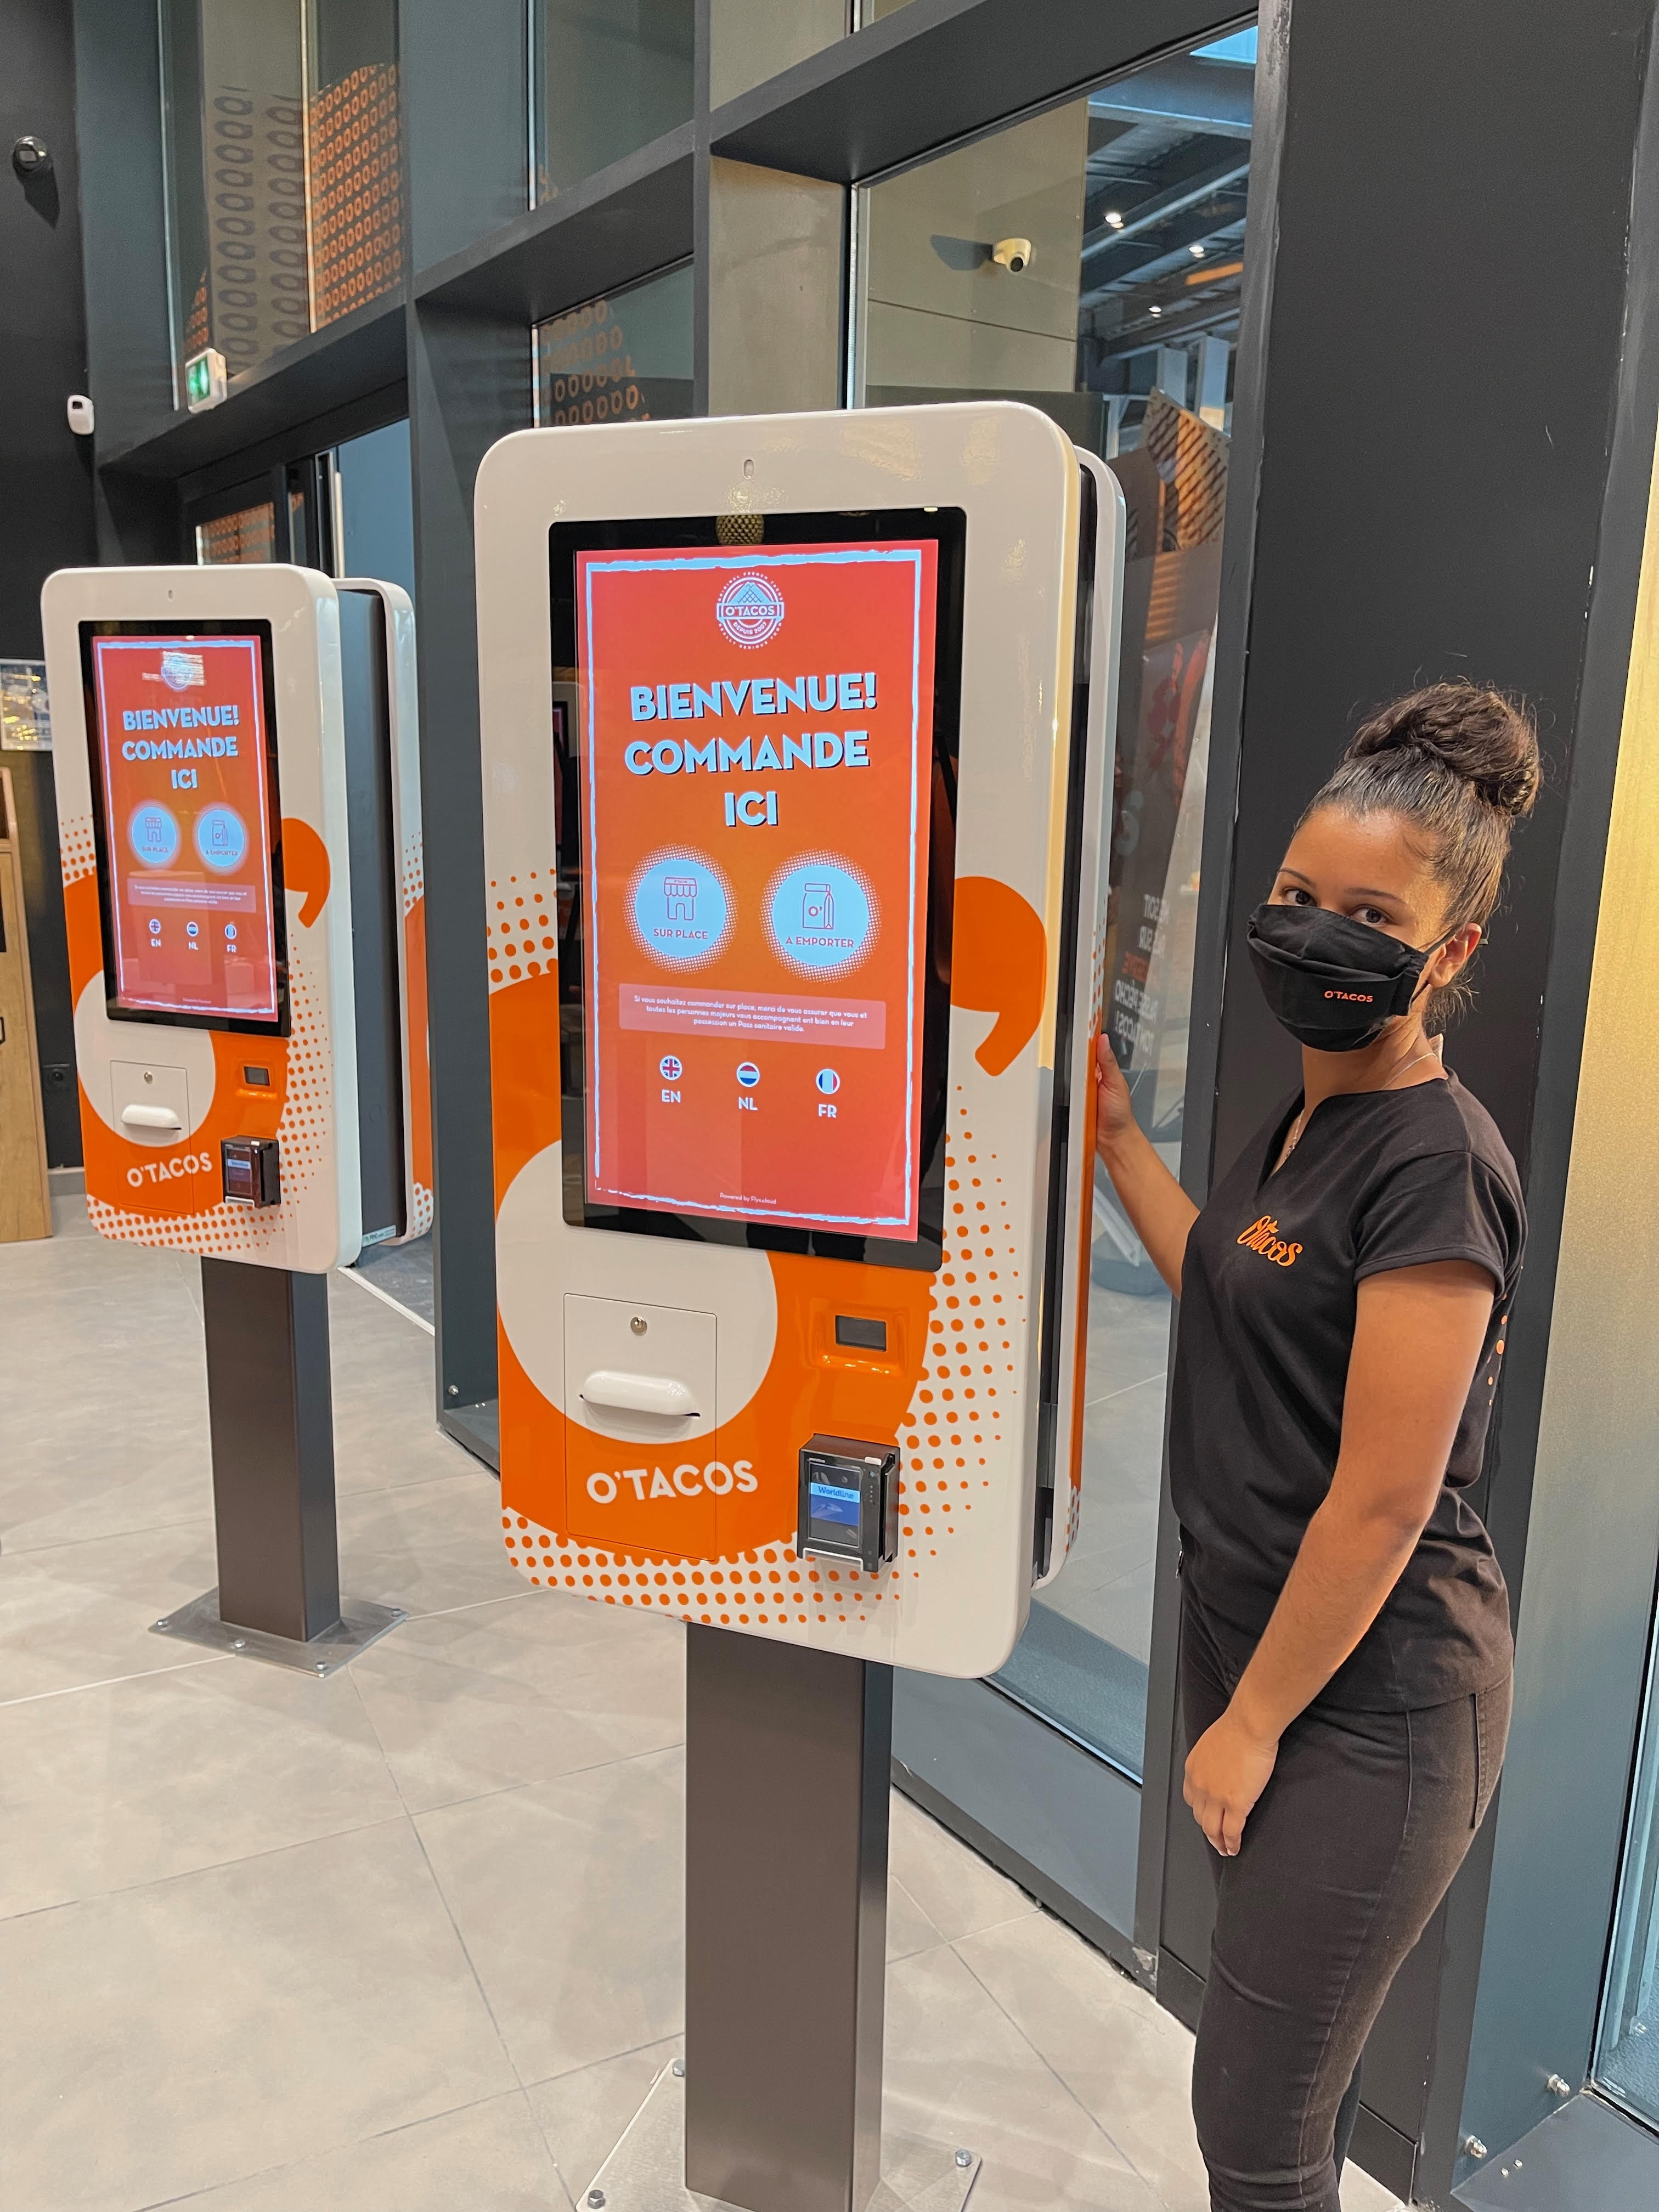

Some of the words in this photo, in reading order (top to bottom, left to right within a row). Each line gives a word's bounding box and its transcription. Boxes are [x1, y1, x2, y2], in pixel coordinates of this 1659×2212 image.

[725, 606, 775, 616] O'TACOS
[733, 622, 753, 635] DEPUIS
[754, 621, 767, 634] 2007
[630, 672, 877, 721] BIENVENUE!
[122, 705, 239, 731] BIENVENUE!
[122, 736, 239, 761] COMMANDE
[624, 731, 870, 775] COMMANDE
[171, 769, 198, 789] ICI
[724, 791, 779, 827] ICI
[653, 928, 673, 938] SUR
[676, 929, 708, 939] PLACE
[151, 939, 161, 947] EN
[188, 942, 198, 951] NL
[227, 944, 236, 953] FR
[786, 936, 793, 945] A
[796, 936, 854, 948] EMPORTER
[1324, 990, 1373, 1002] O'TACOS
[753, 1015, 800, 1023] accompagnant
[662, 1089, 681, 1103] EN
[738, 1097, 758, 1110] NL
[818, 1104, 837, 1118] FR
[127, 1152, 212, 1187] O'TACOS
[720, 1192, 742, 1200] Powered
[586, 1460, 758, 1504] O'TACOS
[818, 1486, 854, 1499] Worldline
